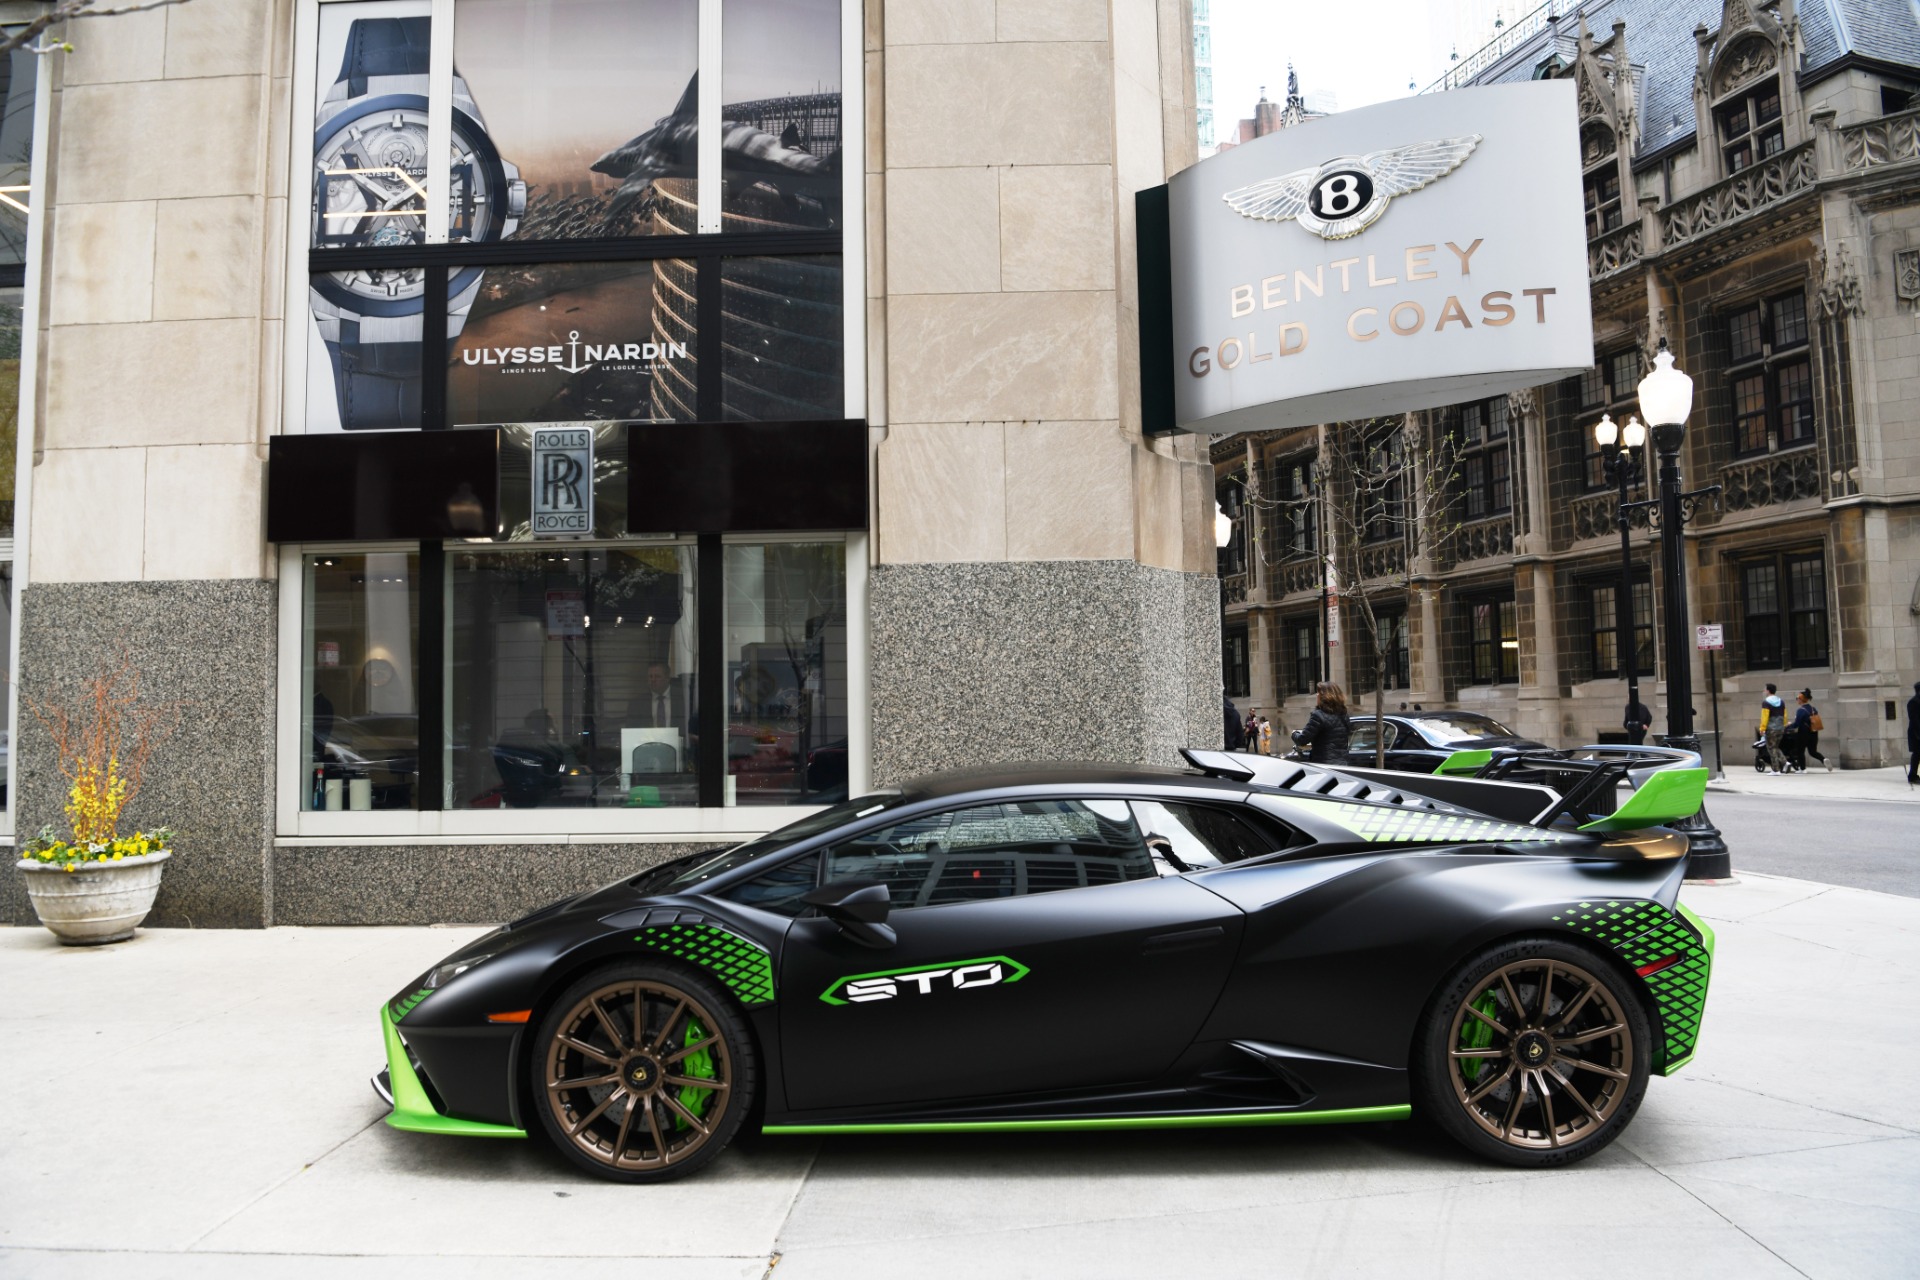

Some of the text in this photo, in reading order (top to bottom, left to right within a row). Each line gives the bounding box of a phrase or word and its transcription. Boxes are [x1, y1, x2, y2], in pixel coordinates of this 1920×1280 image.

[1319, 174, 1360, 215] B
[1231, 238, 1484, 319] BENTLEY
[1188, 287, 1556, 378] GOLD COAST
[463, 342, 687, 365] ULYSSE NARDIN
[538, 433, 586, 447] ROLLS
[537, 515, 585, 529] ROYCE
[846, 963, 1003, 1003] STO
